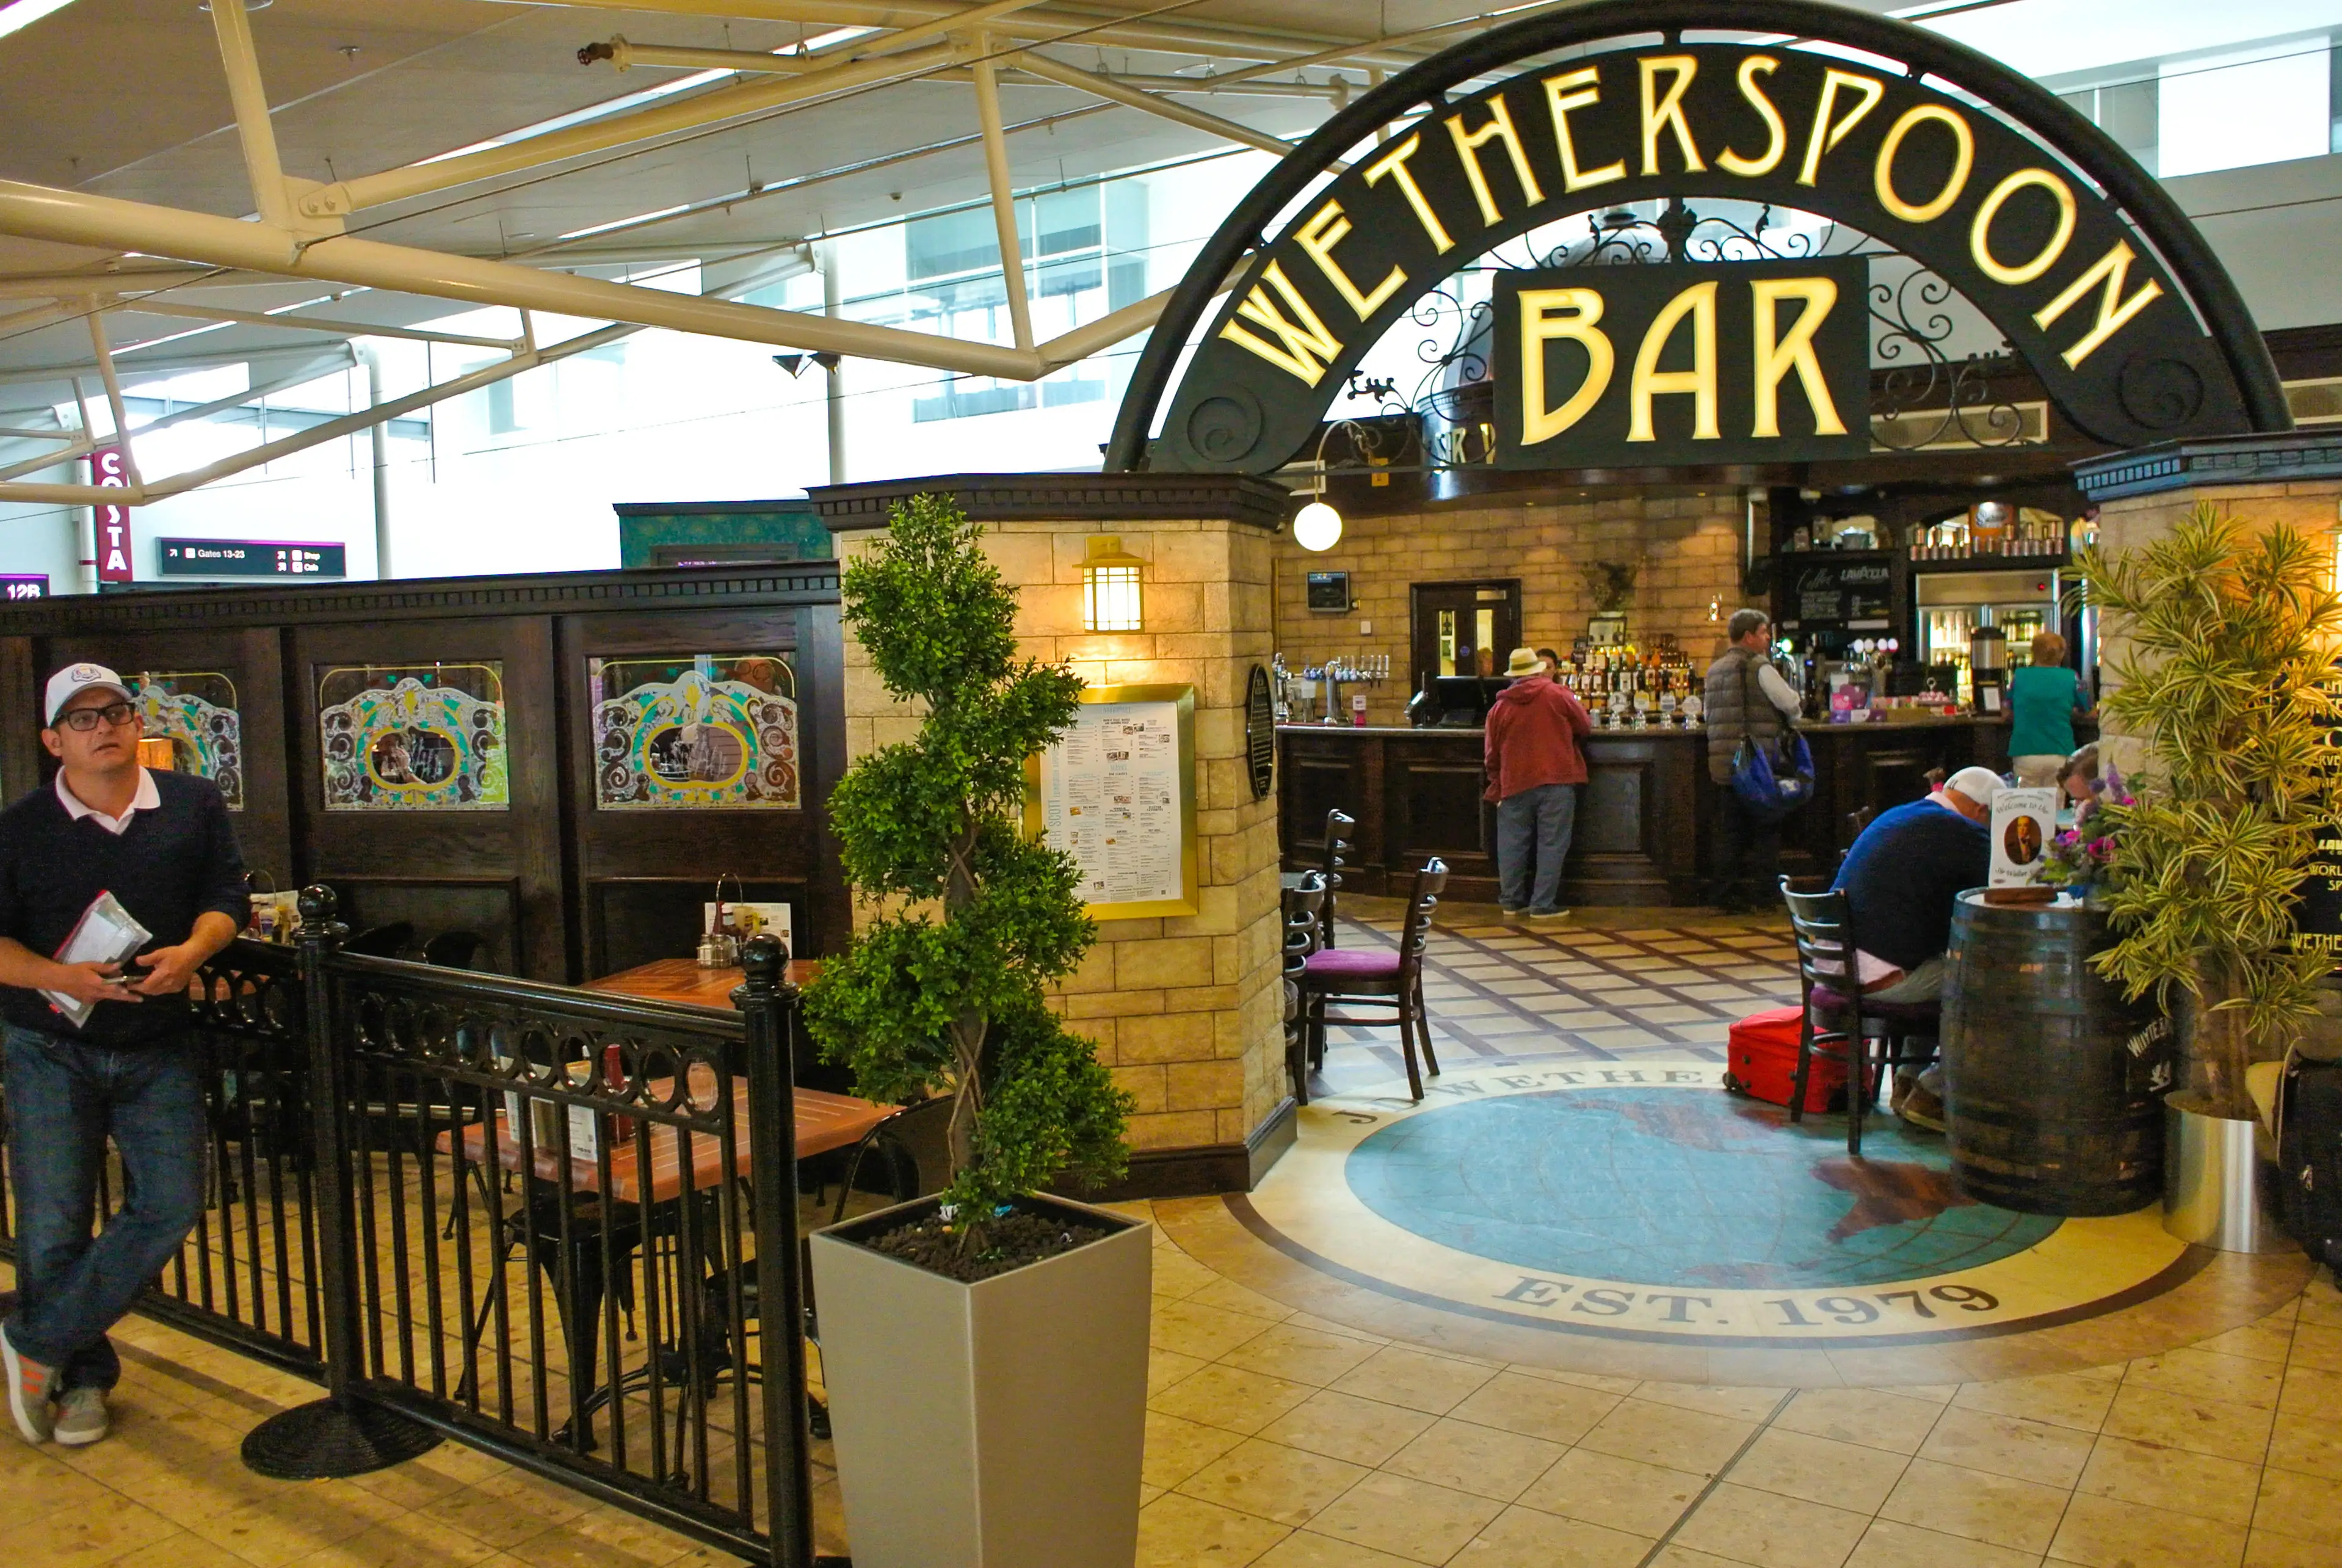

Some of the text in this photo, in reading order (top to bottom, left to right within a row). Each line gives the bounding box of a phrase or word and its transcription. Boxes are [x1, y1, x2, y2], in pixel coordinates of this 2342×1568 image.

[1219, 54, 2164, 388] WETHERSPOON
[1517, 277, 1848, 446] BAR
[198, 549, 245, 559] Gates 13-23
[1840, 565, 1890, 581] LAVAZZA
[1048, 799, 1062, 827] SCOTT
[1492, 1276, 1999, 1326] EST. 1979
